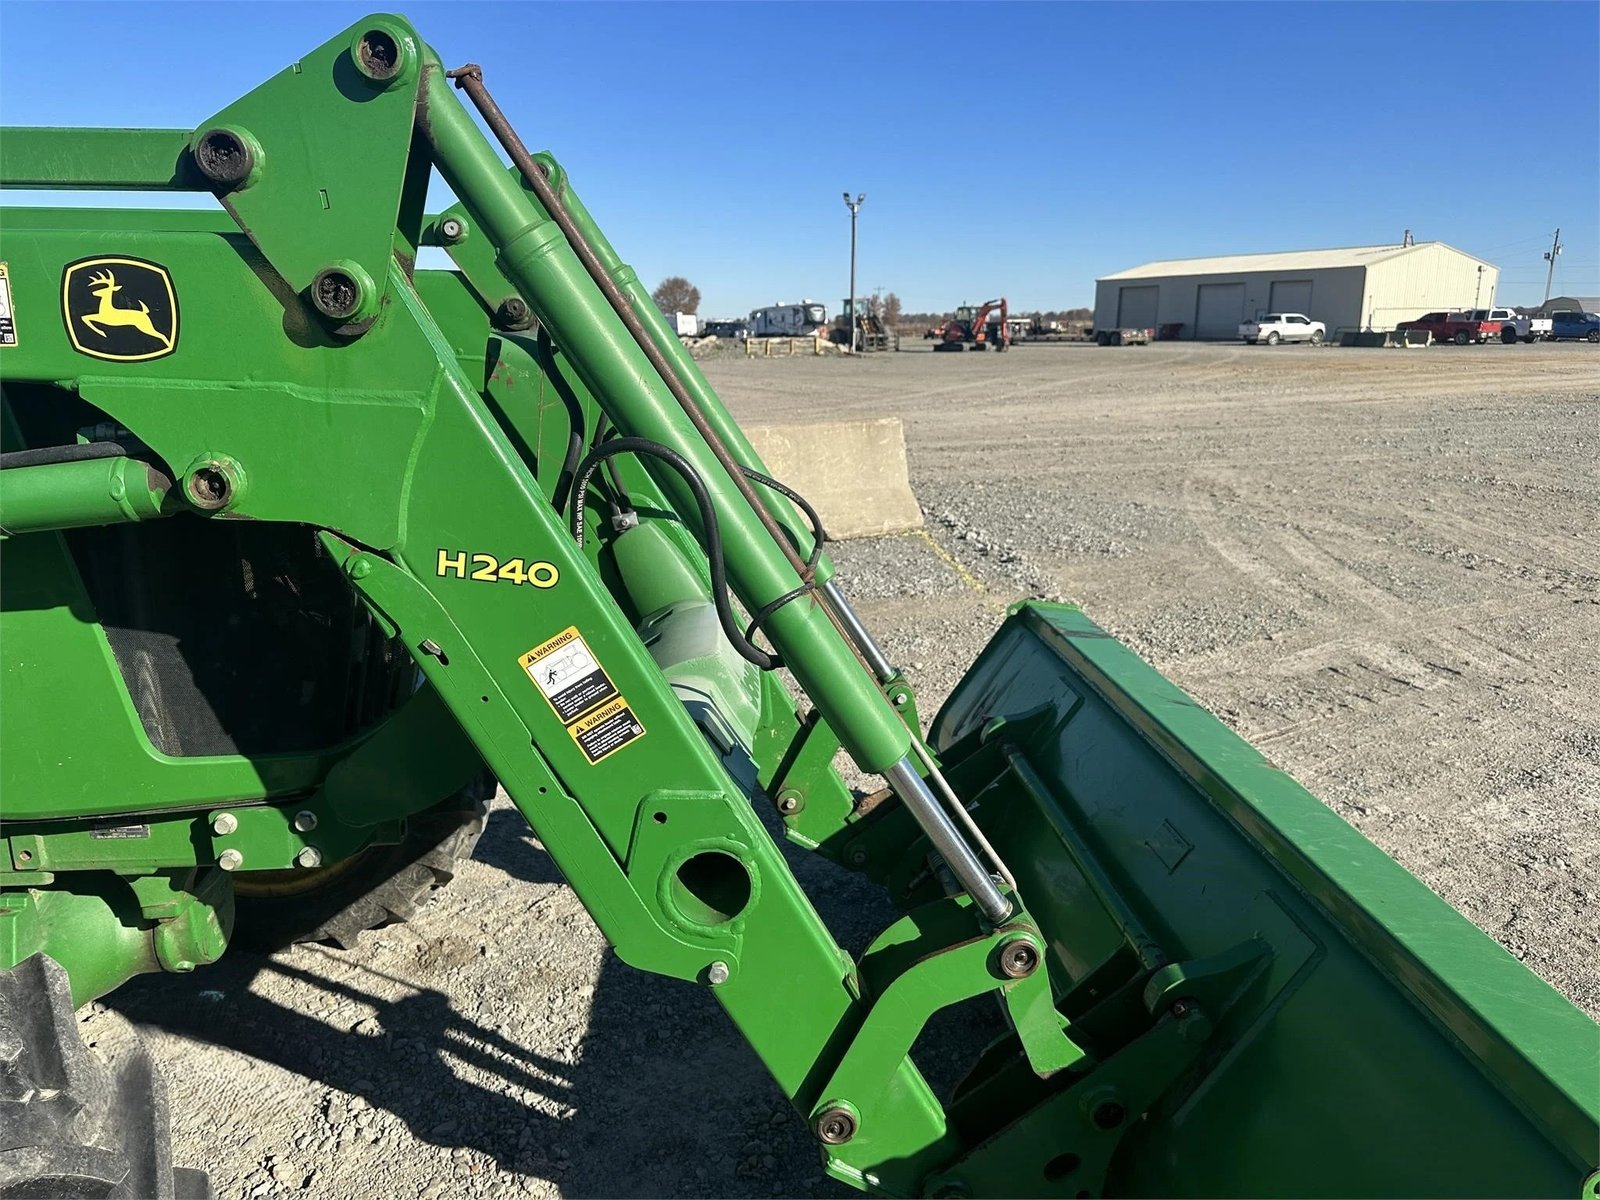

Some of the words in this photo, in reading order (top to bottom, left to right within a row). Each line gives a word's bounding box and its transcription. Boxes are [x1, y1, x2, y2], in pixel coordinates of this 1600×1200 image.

[436, 548, 560, 589] H240
[534, 632, 573, 657] WARNING
[584, 702, 622, 727] WARNING
